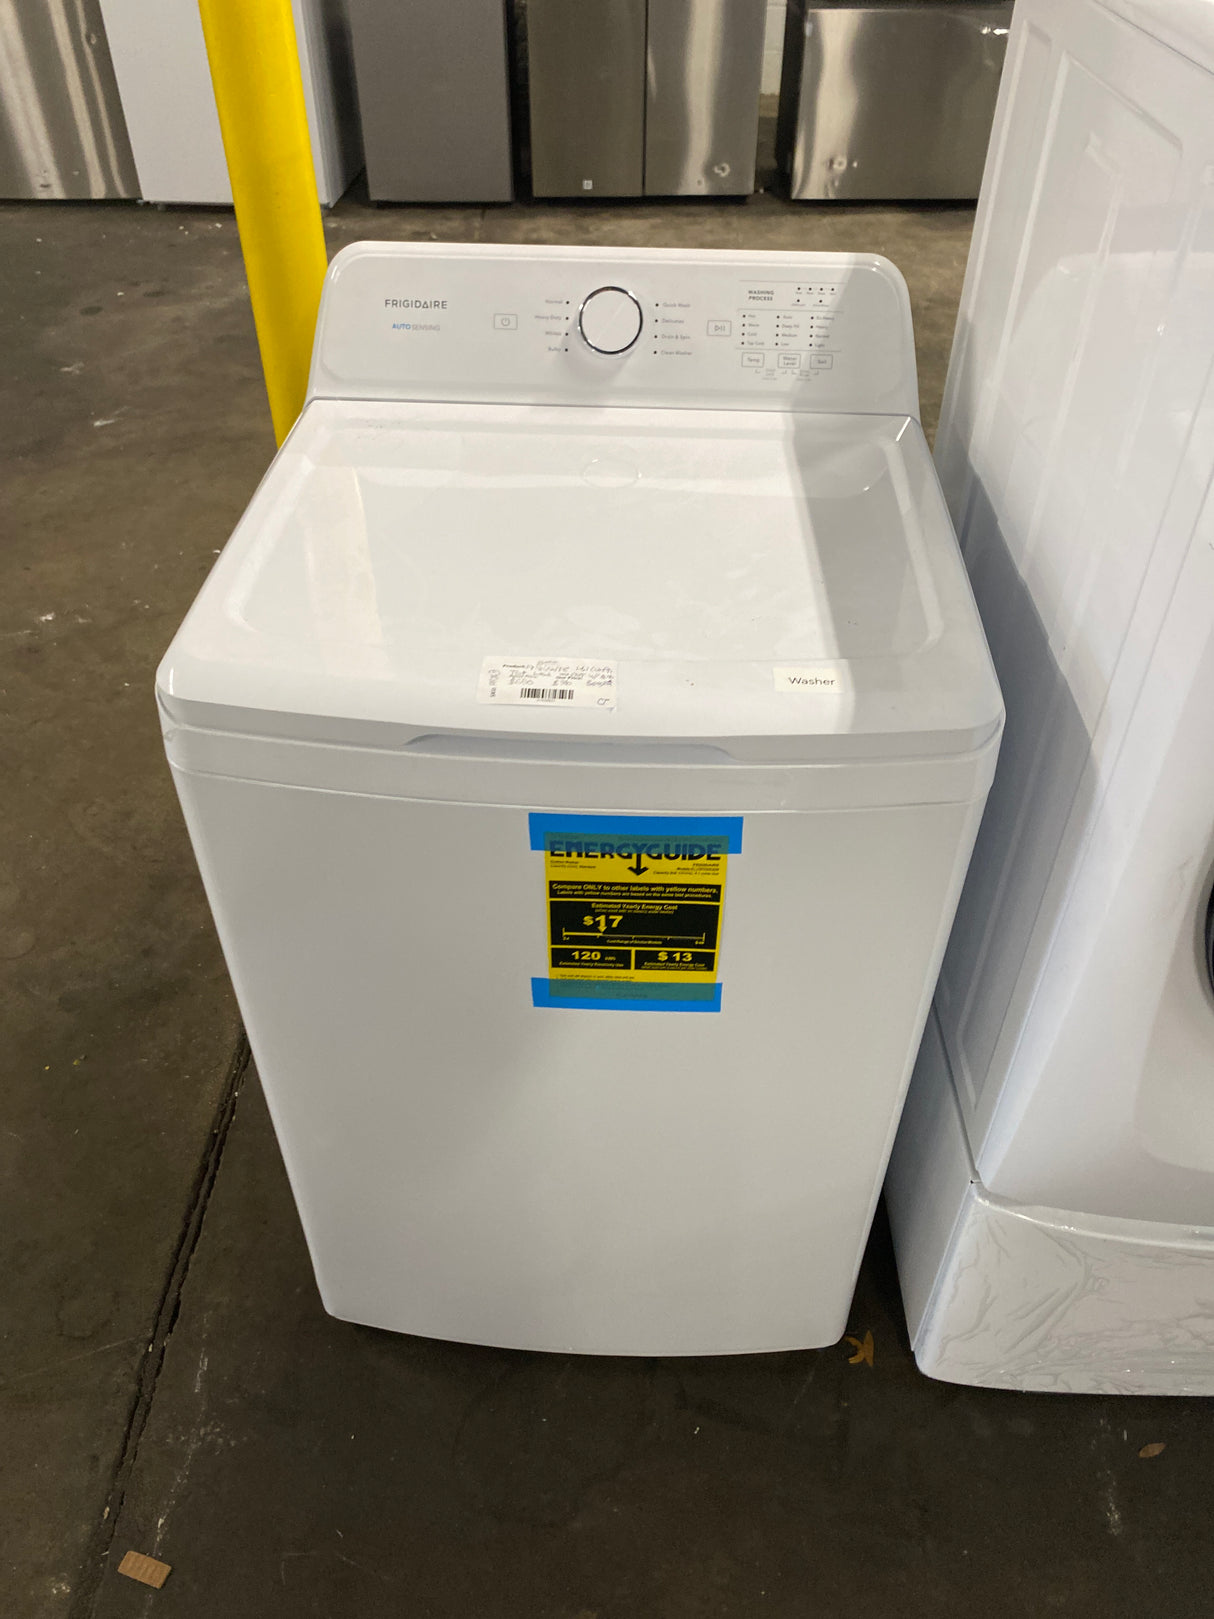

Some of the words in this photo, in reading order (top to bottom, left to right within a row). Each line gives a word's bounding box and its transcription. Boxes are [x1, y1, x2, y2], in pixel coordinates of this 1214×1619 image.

[384, 299, 448, 310] FRIGIDAIRE
[788, 677, 835, 685] Washer
[549, 839, 722, 861] ENERGYGUIDE
[552, 883, 582, 891] Compare
[582, 915, 624, 929] $17
[571, 950, 601, 960] 120
[657, 951, 669, 961] $
[672, 952, 693, 962] 13
